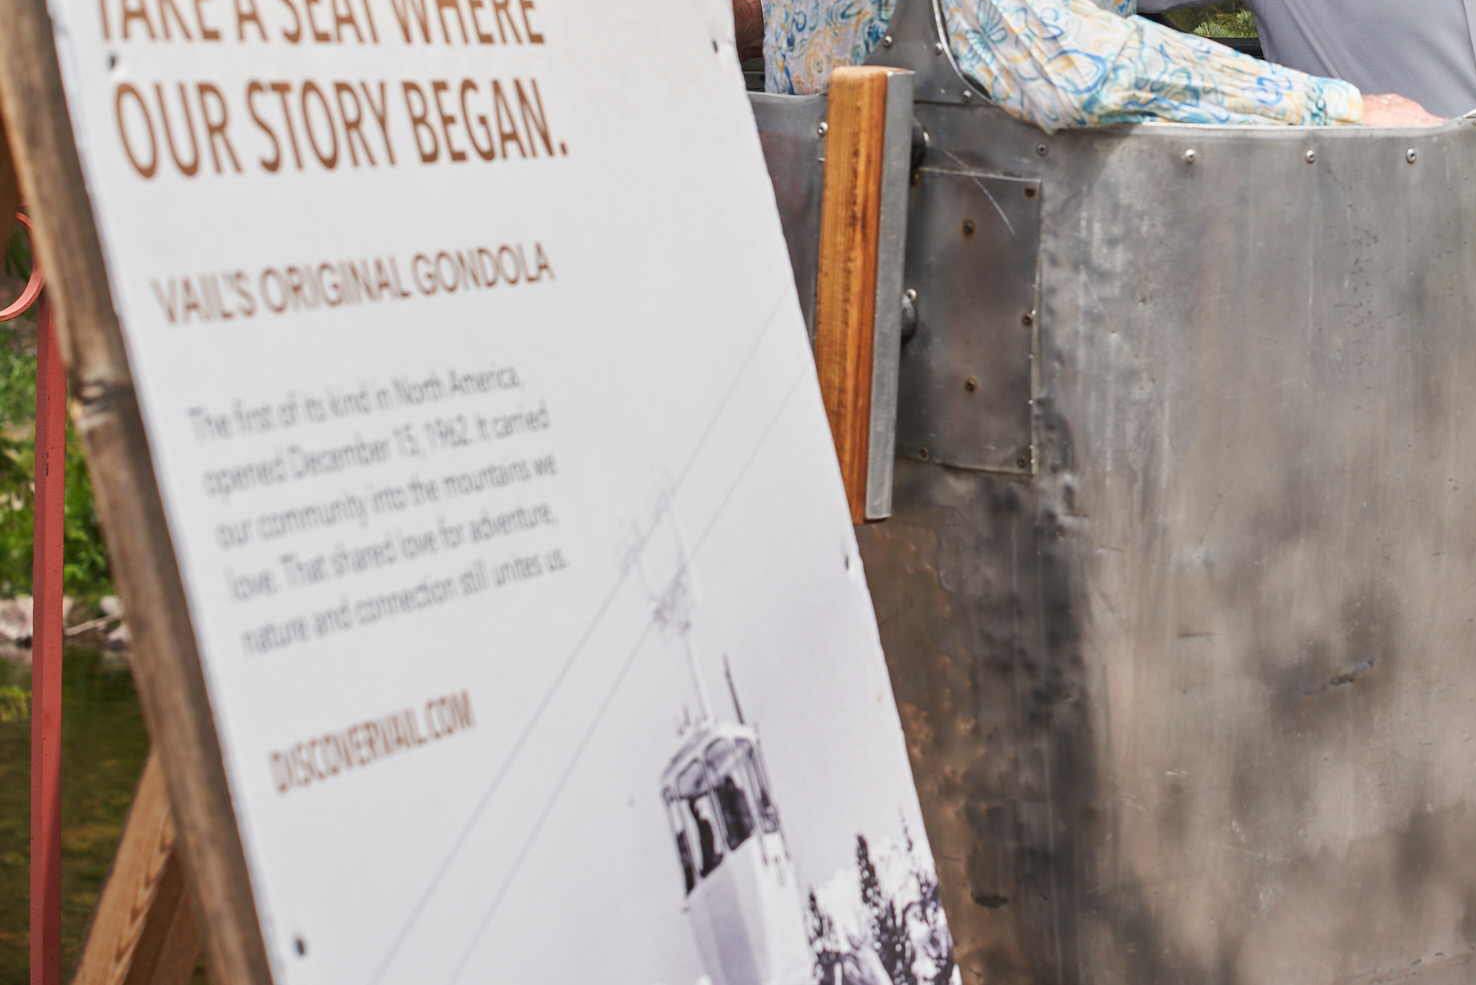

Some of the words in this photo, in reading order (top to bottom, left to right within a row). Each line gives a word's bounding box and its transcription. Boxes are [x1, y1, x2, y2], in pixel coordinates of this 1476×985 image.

[115, 81, 243, 181] OUR
[246, 80, 396, 173] STORY
[402, 79, 568, 163] BEGAN.
[151, 271, 257, 326] VAIL'S
[259, 255, 411, 315] ORIGINAL
[412, 241, 555, 296] GONDOLA
[186, 405, 232, 441] The
[231, 397, 276, 434] first
[276, 389, 299, 429] of
[302, 391, 328, 423] its
[325, 382, 371, 417] kind
[372, 381, 394, 411] in
[392, 368, 445, 405] North
[202, 446, 287, 504] opened
[286, 432, 390, 480] December
[475, 411, 491, 441] It
[491, 398, 551, 438] carried
[215, 520, 252, 551] our
[257, 489, 368, 541] community
[368, 482, 409, 513] into
[408, 472, 440, 505] the
[442, 456, 532, 497] mountains
[534, 454, 559, 477] we
[279, 552, 329, 587] That
[331, 539, 398, 578] shared
[395, 527, 439, 559] love
[437, 517, 464, 549] for
[240, 616, 310, 654] nature
[313, 593, 352, 638] and
[354, 574, 459, 626] connection
[459, 558, 491, 596] still
[493, 552, 544, 588] unites
